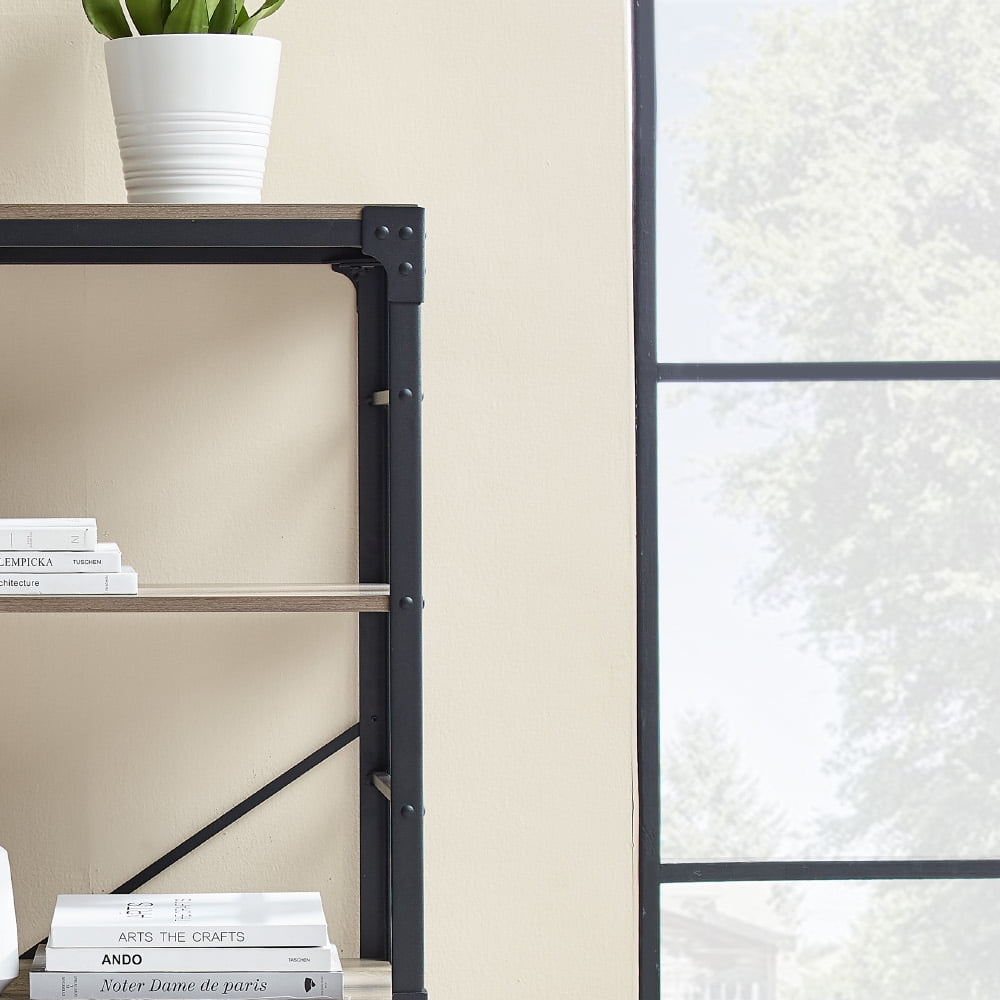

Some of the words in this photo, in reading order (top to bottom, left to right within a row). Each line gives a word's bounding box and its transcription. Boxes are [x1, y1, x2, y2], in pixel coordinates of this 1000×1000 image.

[118, 931, 154, 943] ARTS
[160, 931, 186, 943] THE
[192, 931, 245, 943] CRAFTS
[101, 954, 143, 965] ANDO
[100, 978, 145, 992] Noter
[149, 978, 196, 992] Dame
[200, 978, 219, 992] de
[222, 978, 268, 994] paris
